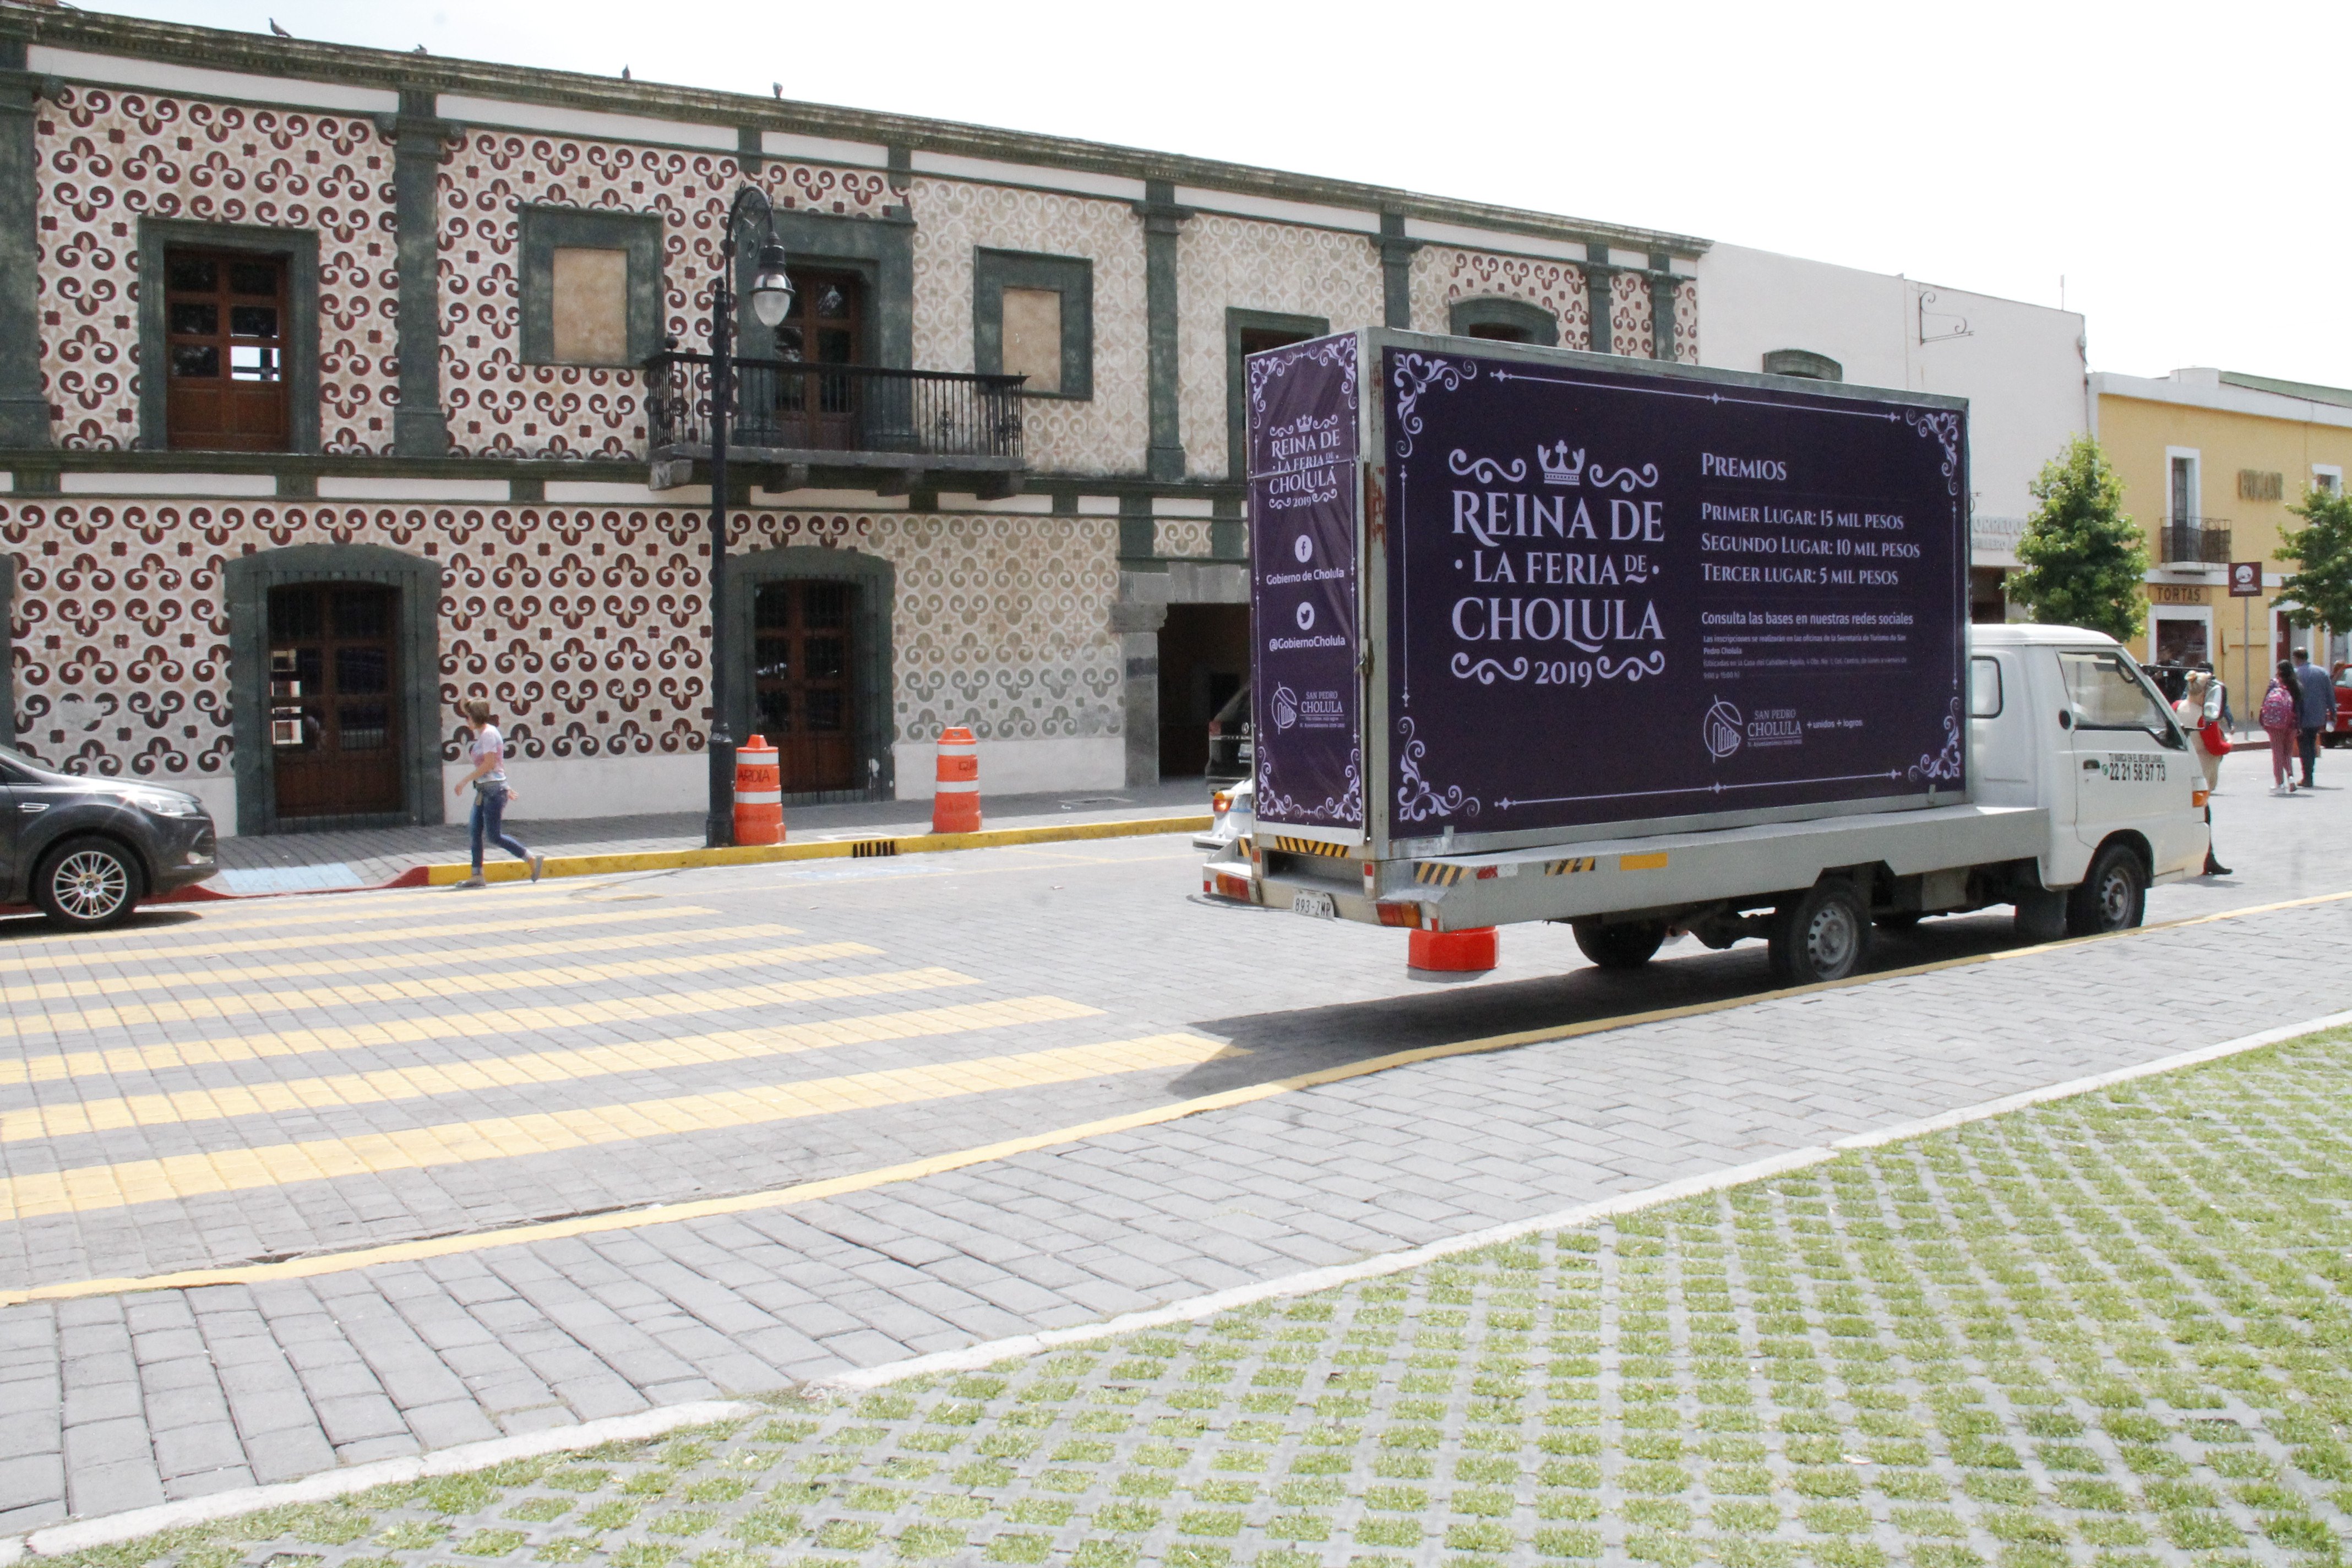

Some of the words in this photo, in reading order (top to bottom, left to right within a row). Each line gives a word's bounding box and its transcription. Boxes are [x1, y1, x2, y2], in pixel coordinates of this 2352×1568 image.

[1271, 434, 1316, 460] REINA
[1320, 429, 1341, 449] DE
[1278, 461, 1291, 472] LA
[1294, 455, 1324, 471] FERIA
[1326, 451, 1334, 460] DE
[1269, 469, 1337, 494] CHOLULA
[1293, 497, 1311, 507] 2019
[1451, 490, 1598, 547] REINA
[1609, 499, 1664, 542] DE
[1701, 502, 1760, 522] PRIMER
[1764, 506, 1816, 525] LUGAR:
[1820, 509, 1833, 527] 15
[1837, 513, 1861, 527] MIL
[1864, 514, 1904, 530] PESOS
[1701, 533, 1777, 553] SEGUNDO
[1781, 536, 1833, 555] LUGAR:
[1837, 538, 1851, 556] 10
[1854, 542, 1878, 557] MIL
[1882, 542, 1920, 558] PESOS
[1266, 574, 1300, 585] Gobierno
[1302, 570, 1312, 581] de
[1313, 568, 1344, 580] Cholula
[1473, 551, 1516, 584] LA
[1526, 552, 1620, 585] FERIA
[1624, 554, 1647, 573] DE
[1701, 563, 1761, 582] TERCER
[1764, 567, 1816, 583] LUGAR:
[1820, 567, 1827, 584] 5
[1831, 570, 1855, 584] MIL
[1859, 570, 1898, 585] PESOS
[2157, 586, 2201, 602] TORTAS
[1451, 597, 1665, 652] CHOLULA
[1702, 611, 1746, 624] Consulta
[1749, 611, 1762, 624] las
[1766, 611, 1793, 624] bases
[1796, 614, 1807, 624] en
[1810, 613, 1849, 624] nuestras
[1852, 612, 1876, 624] redes
[1879, 612, 1913, 625] sociales
[1269, 635, 1346, 651] @GobiernoCholula
[1534, 661, 1592, 687] 2019
[1306, 691, 1317, 699] SAN
[1319, 690, 1338, 699] PEDRO
[1301, 701, 1343, 713] CHOLULA
[1755, 710, 1770, 720] SAN
[1772, 709, 1796, 719] PEDRO
[1747, 721, 1802, 737] CHOLULA
[2110, 763, 2119, 780] 22
[2121, 763, 2131, 780] 21
[2134, 764, 2142, 781] 58
[2145, 764, 2154, 781] 97
[2157, 764, 2165, 781] 73
